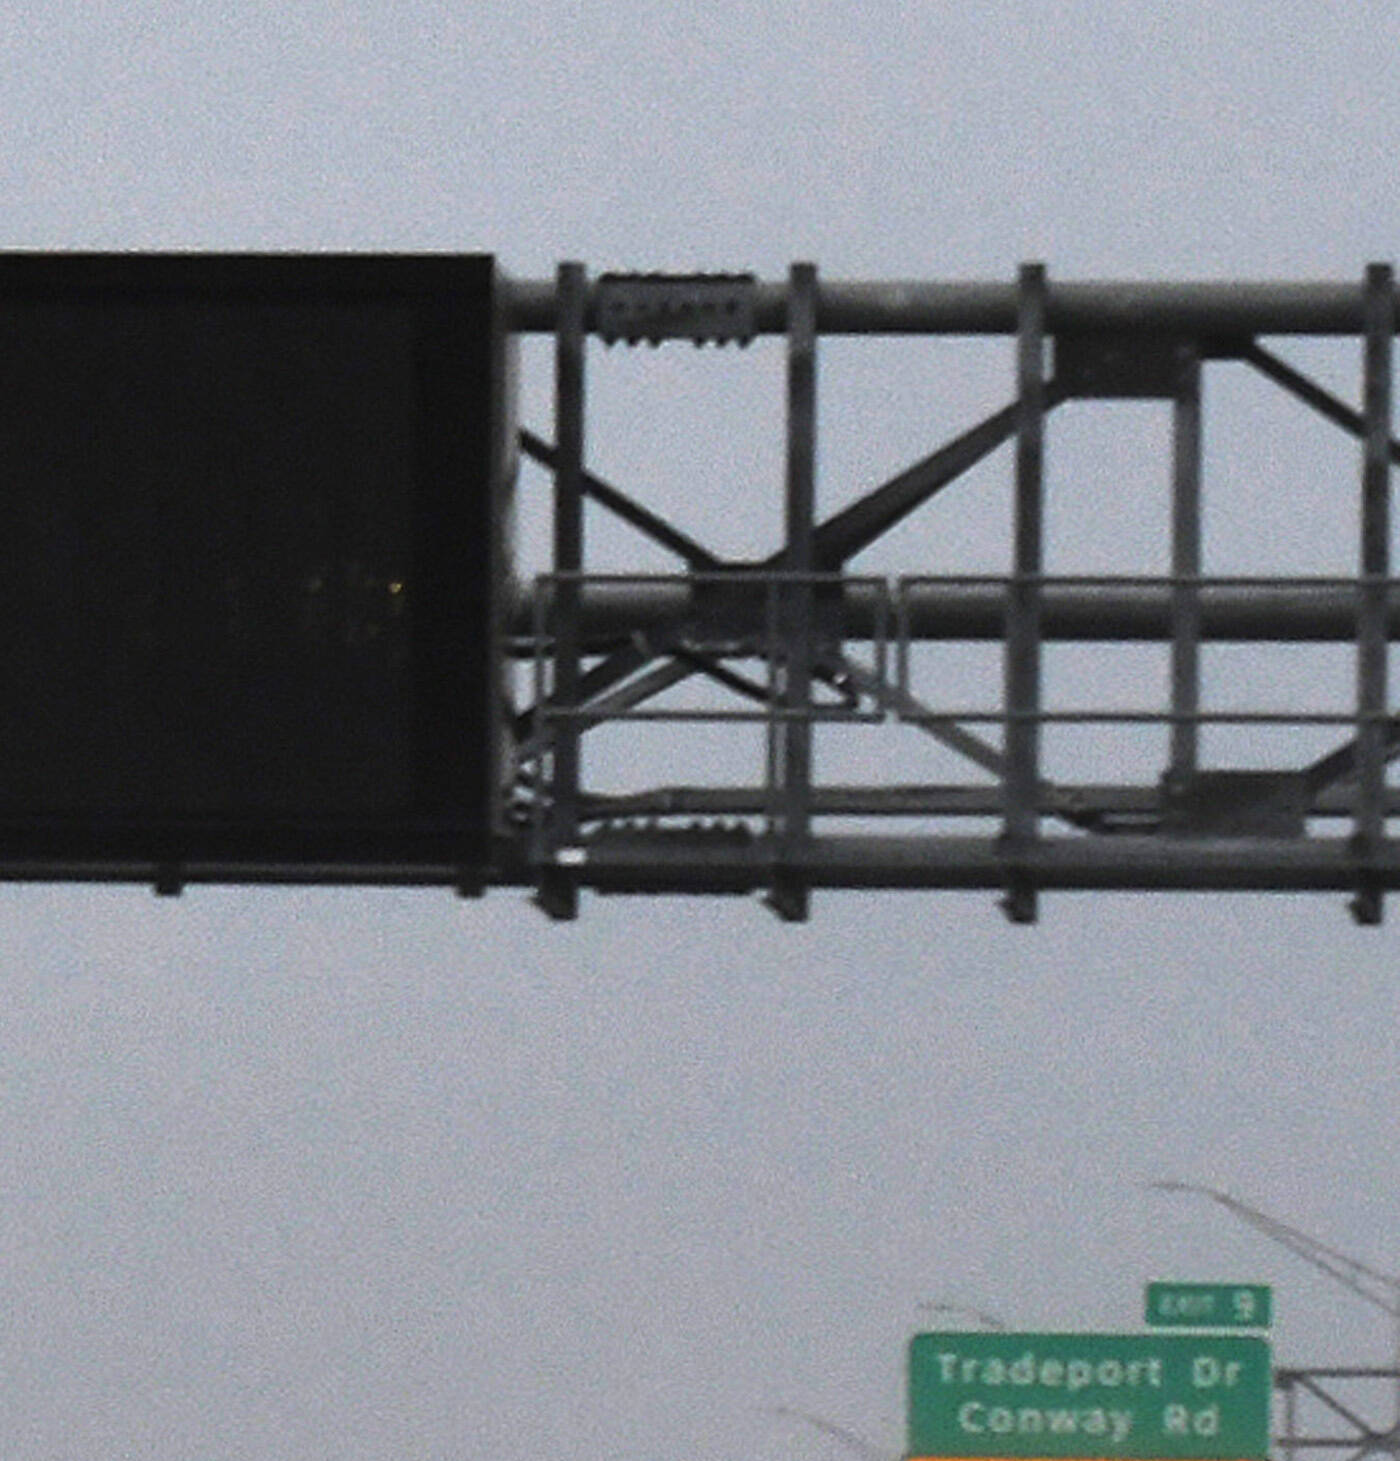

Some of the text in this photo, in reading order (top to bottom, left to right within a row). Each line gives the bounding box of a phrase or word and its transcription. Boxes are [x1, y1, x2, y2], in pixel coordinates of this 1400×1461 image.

[1231, 1290, 1256, 1322] 9
[937, 1351, 1244, 1391] Tradeport Dr
[957, 1401, 1221, 1443] Conway Rd
